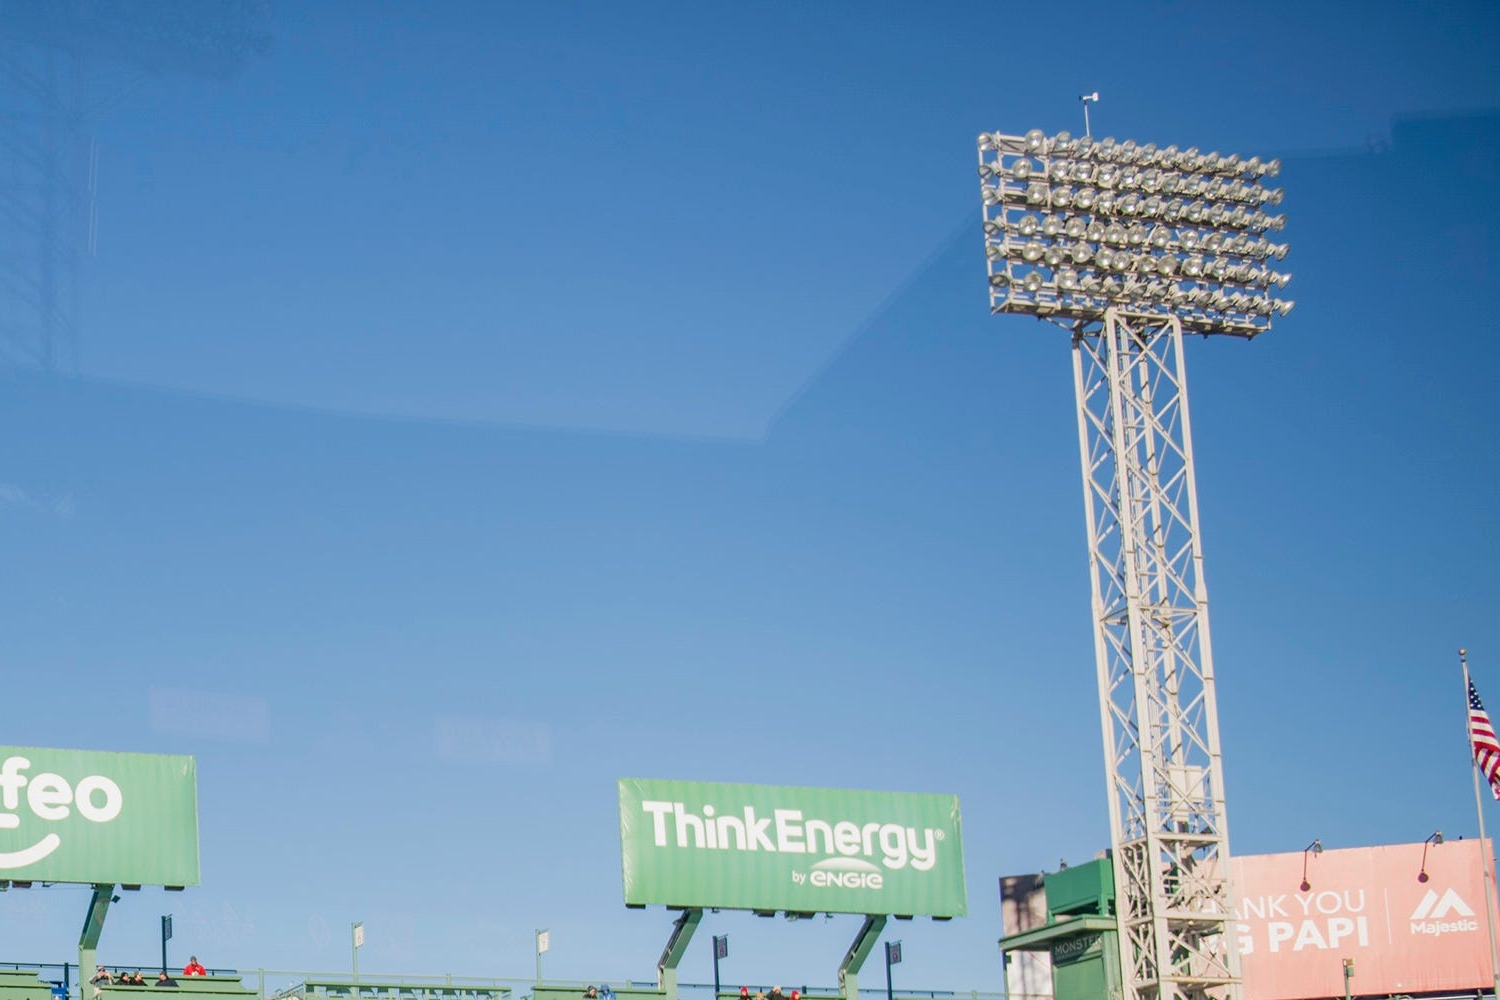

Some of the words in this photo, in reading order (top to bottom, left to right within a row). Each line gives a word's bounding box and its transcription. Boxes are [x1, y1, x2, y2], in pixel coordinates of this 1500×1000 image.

[792, 870, 806, 886] by
[1294, 889, 1365, 915] YOU
[1267, 916, 1368, 952] PAPI
[1410, 919, 1479, 937] Majestic
